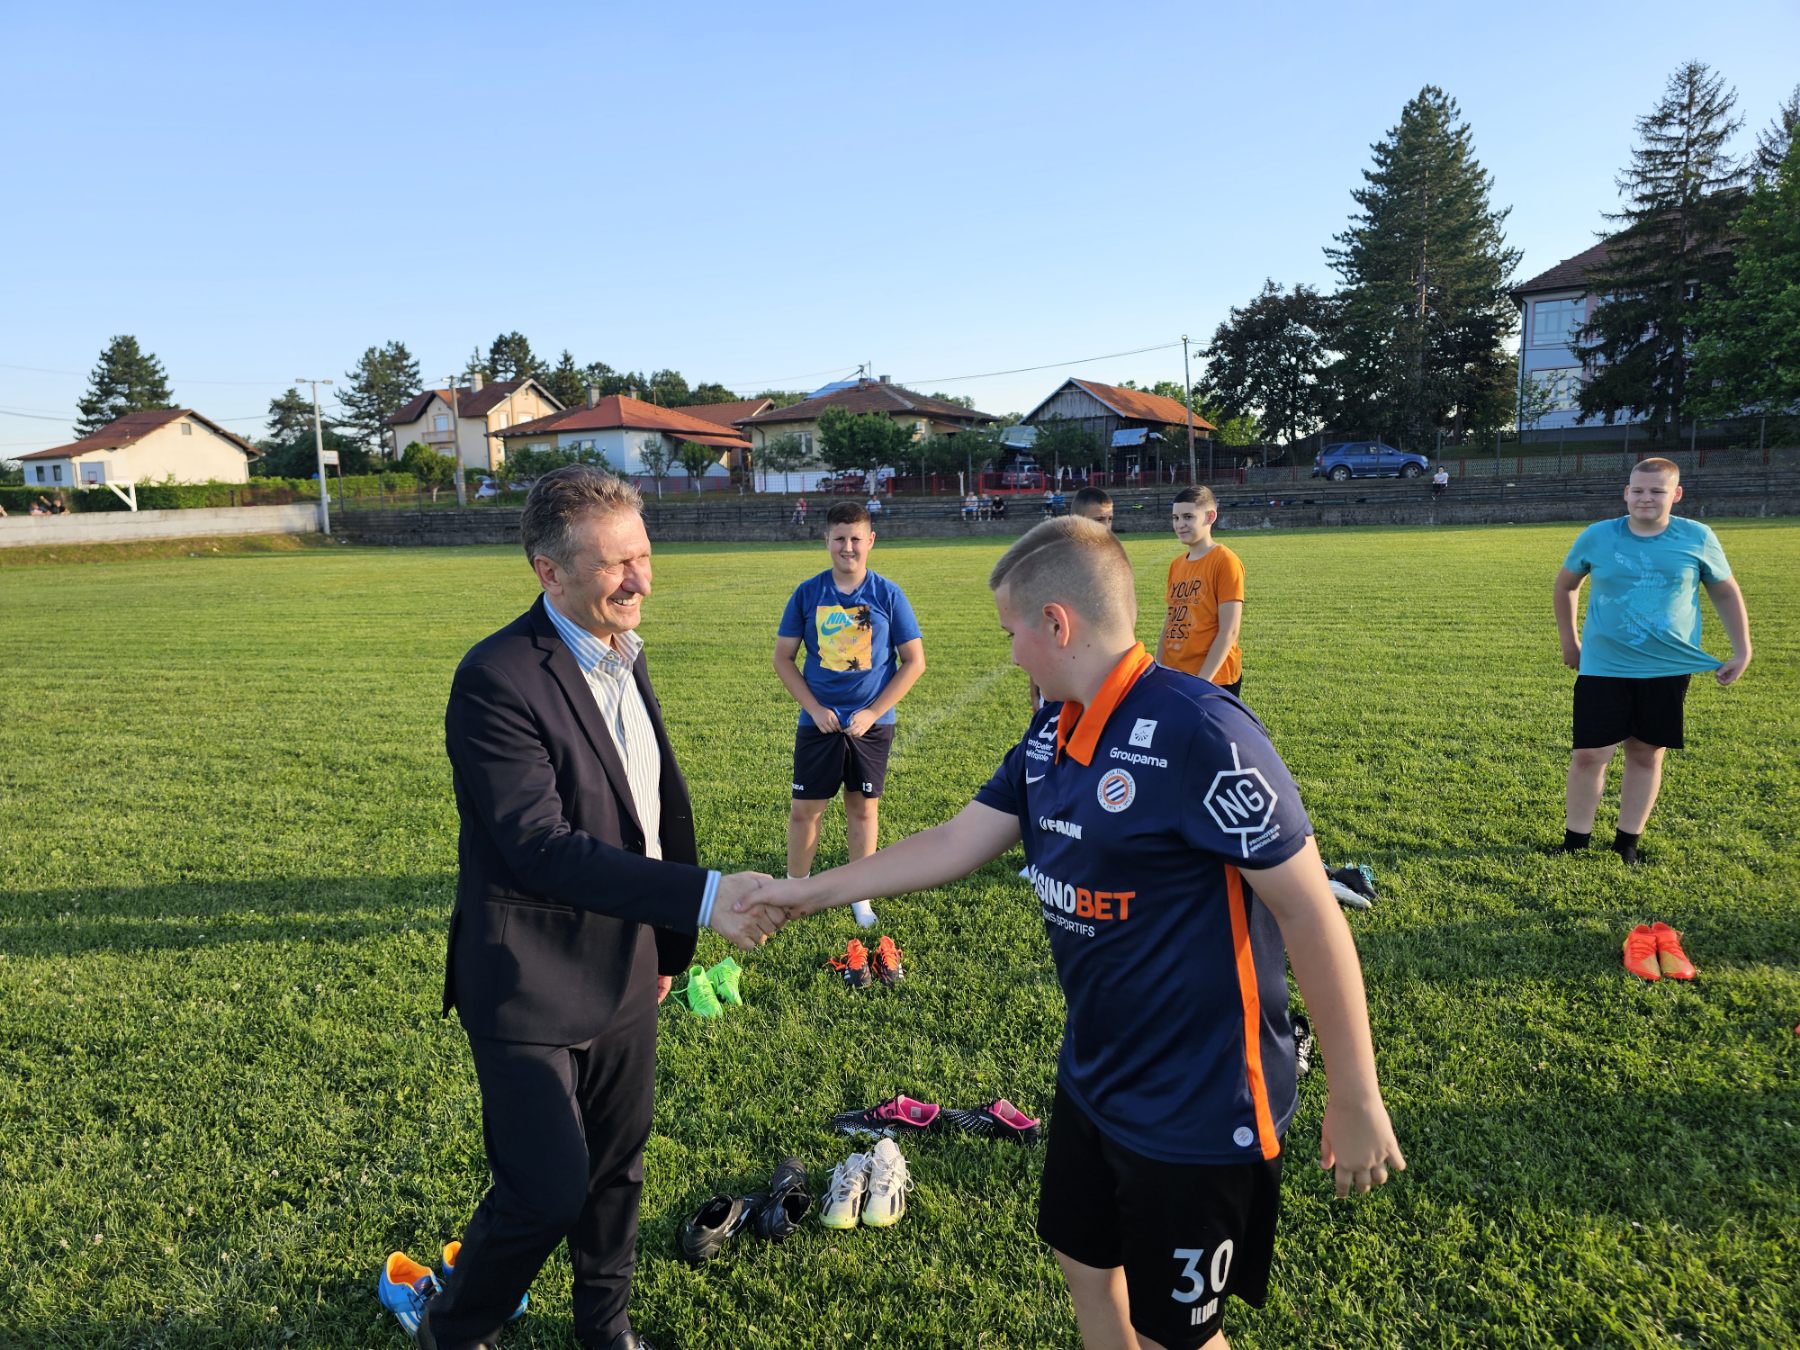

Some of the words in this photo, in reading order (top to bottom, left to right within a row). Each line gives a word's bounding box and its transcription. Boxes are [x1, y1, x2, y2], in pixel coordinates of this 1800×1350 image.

[1170, 580, 1201, 598] YOUR
[1109, 747, 1168, 768] Groupama
[862, 782, 873, 793] 13
[1215, 779, 1265, 825] NG
[1030, 864, 1136, 921] SINOBET
[1056, 915, 1096, 937] SPORTIFS
[1171, 1239, 1234, 1303] 30
